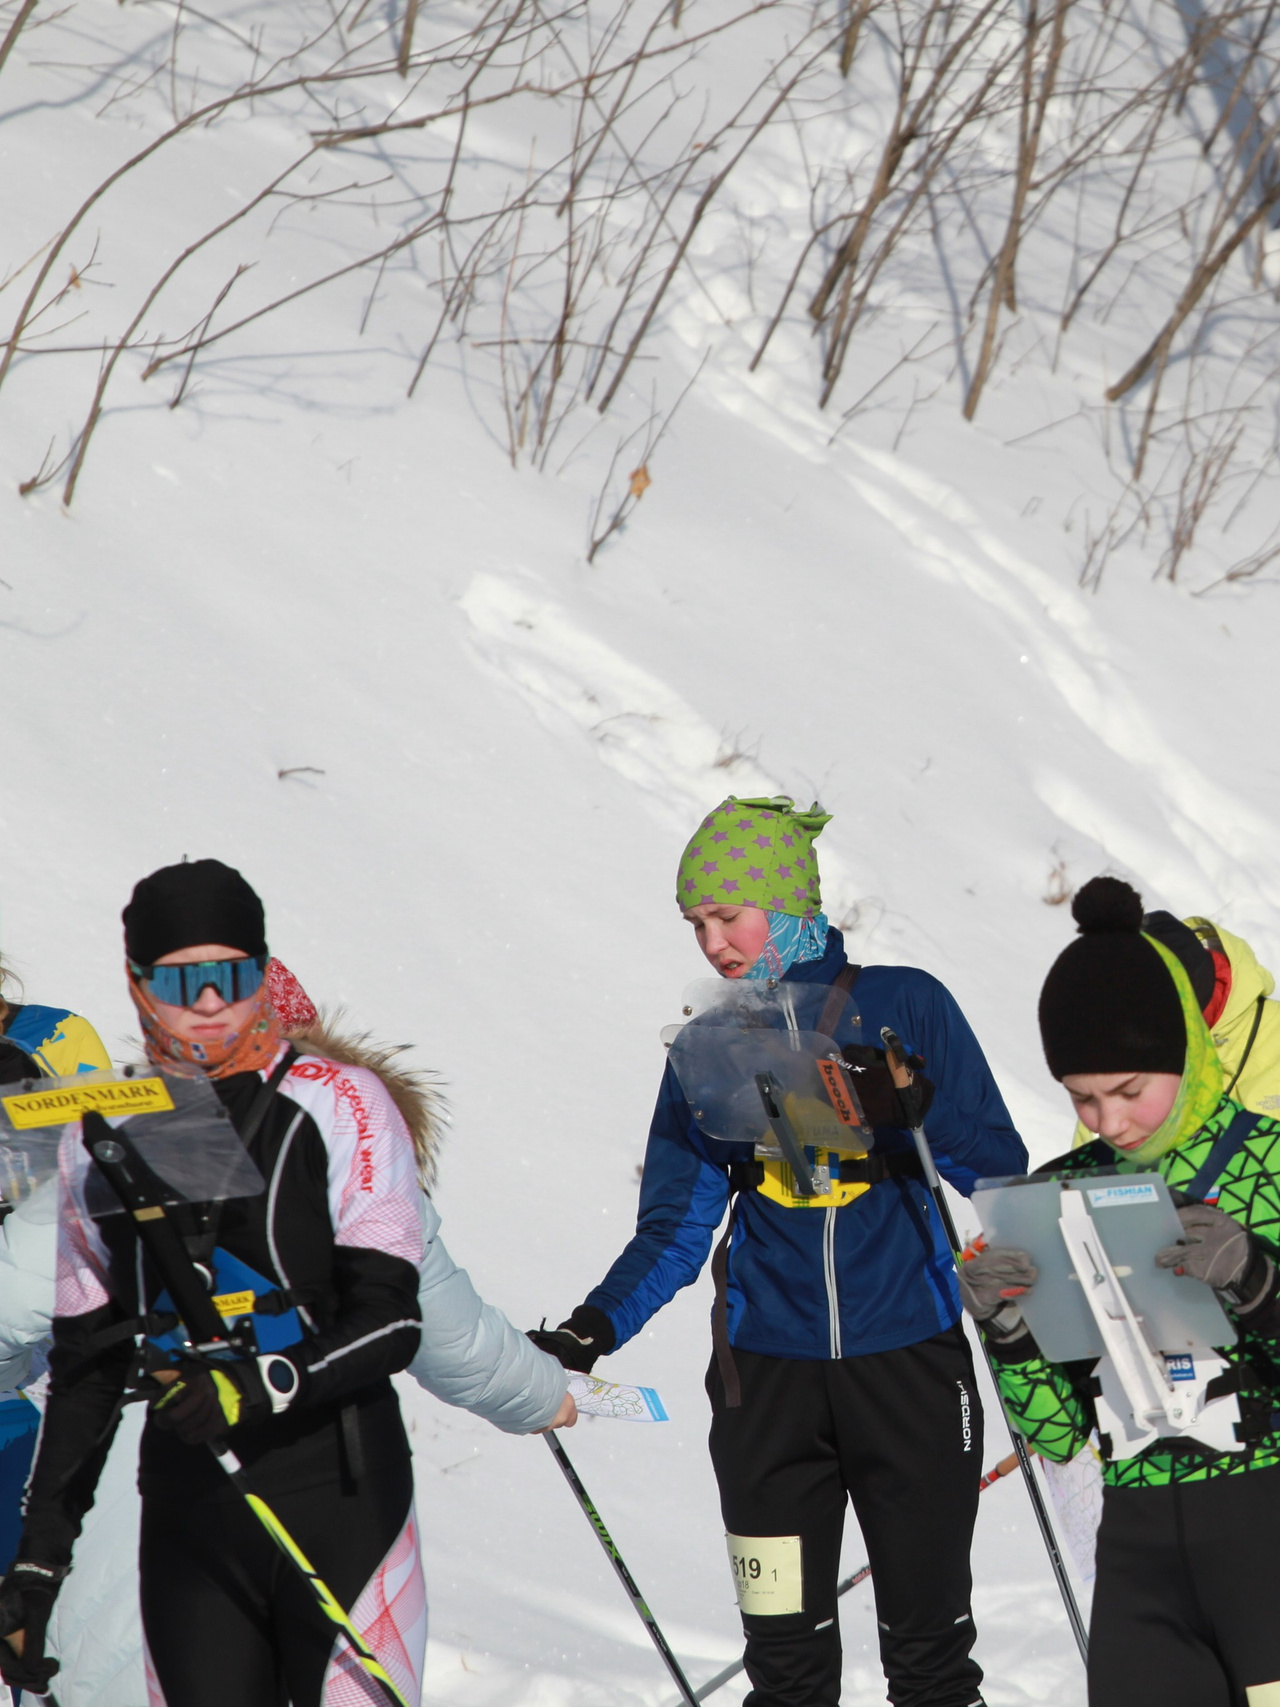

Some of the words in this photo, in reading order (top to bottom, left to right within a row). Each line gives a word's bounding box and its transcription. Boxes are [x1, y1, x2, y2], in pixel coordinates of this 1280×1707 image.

[12, 1083, 160, 1115] NORDENMARK
[334, 1076, 374, 1142] special
[360, 1144, 374, 1194] wear
[580, 1492, 622, 1561] SWIX
[732, 1554, 761, 1580] 519
[771, 1568, 778, 1582] 1
